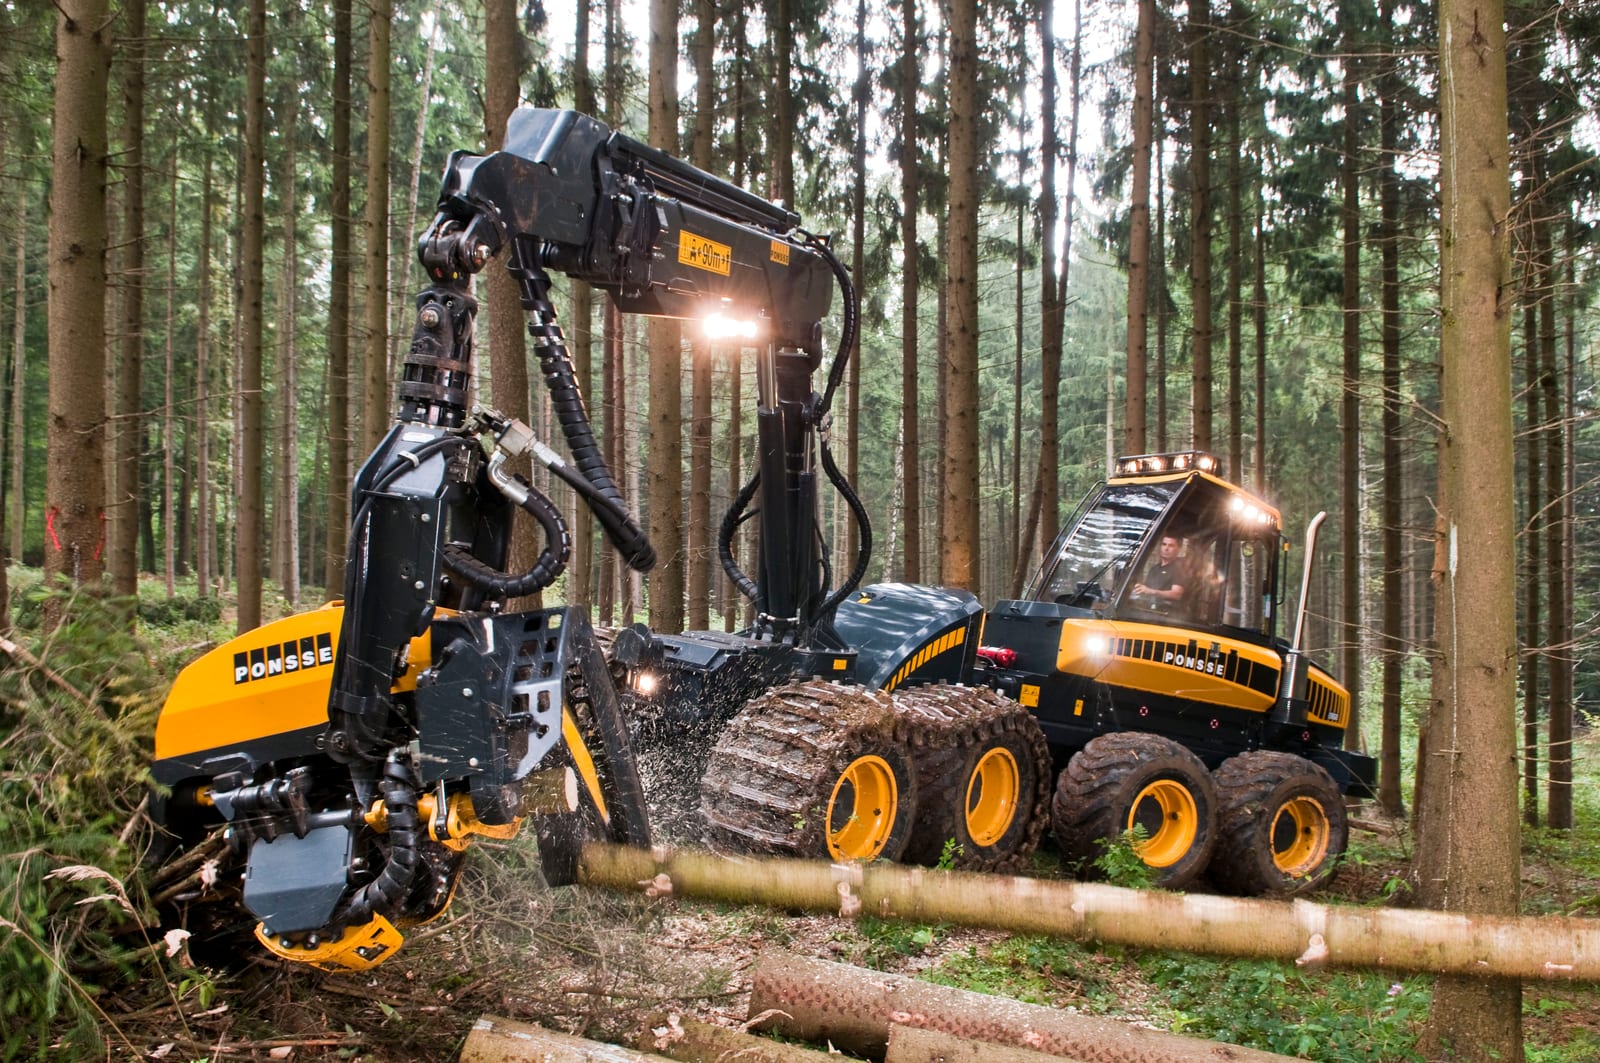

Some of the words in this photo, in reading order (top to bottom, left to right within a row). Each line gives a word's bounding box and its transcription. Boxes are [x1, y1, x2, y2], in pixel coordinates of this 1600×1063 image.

[702, 243, 720, 268] 90m
[235, 646, 333, 682] PONSSE
[1165, 651, 1225, 676] PONSSE
